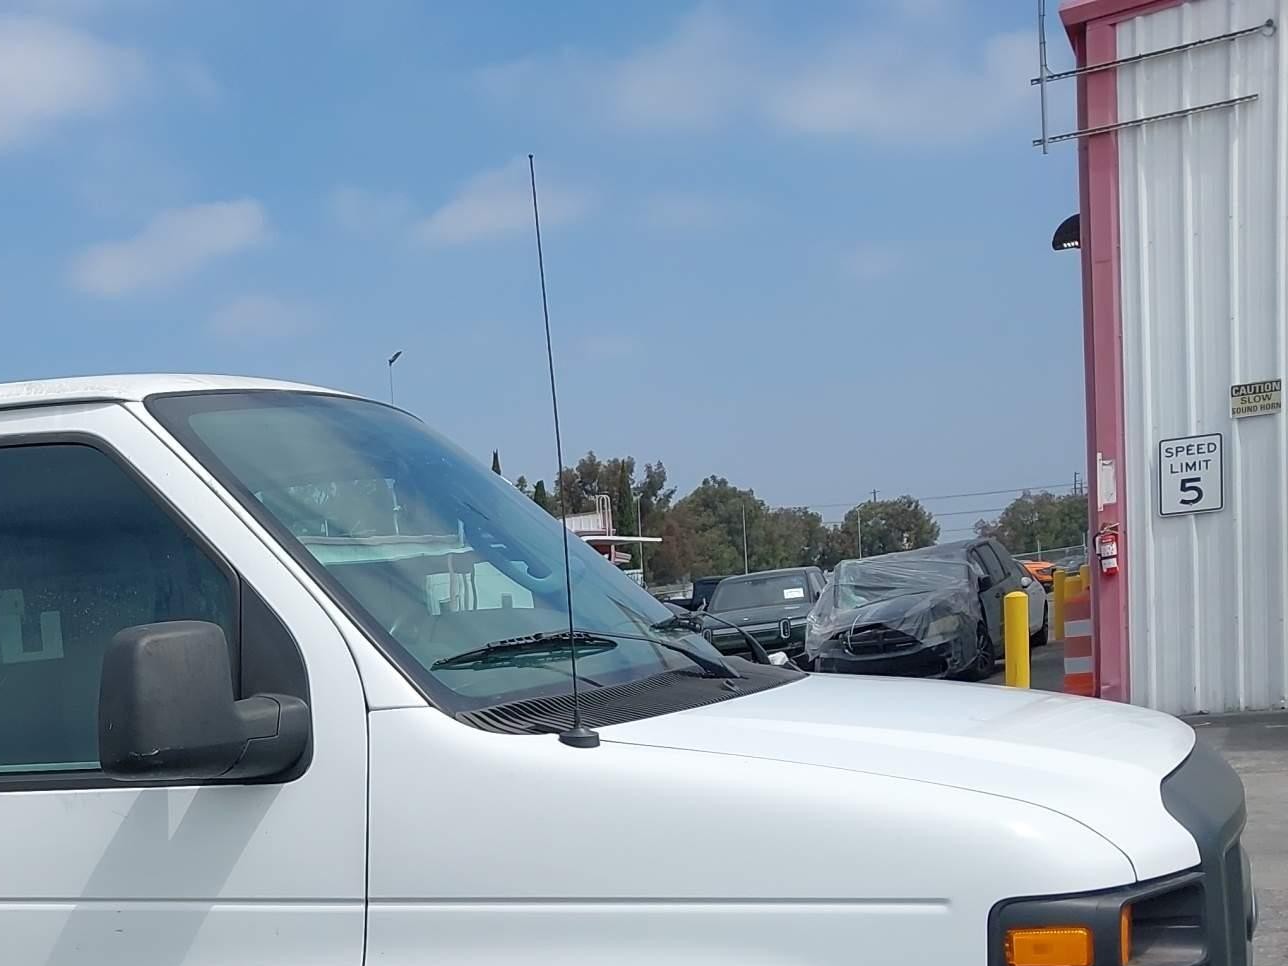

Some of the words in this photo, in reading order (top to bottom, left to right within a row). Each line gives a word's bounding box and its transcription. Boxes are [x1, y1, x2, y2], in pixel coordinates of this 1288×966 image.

[1232, 382, 1281, 396] CAUTION
[1240, 393, 1272, 405] SLOW
[1232, 405, 1258, 415] SOUND
[1259, 402, 1281, 411] HORN
[1164, 442, 1217, 458] SPEED
[1170, 459, 1212, 474] LIMIT
[1179, 476, 1204, 506] 5
